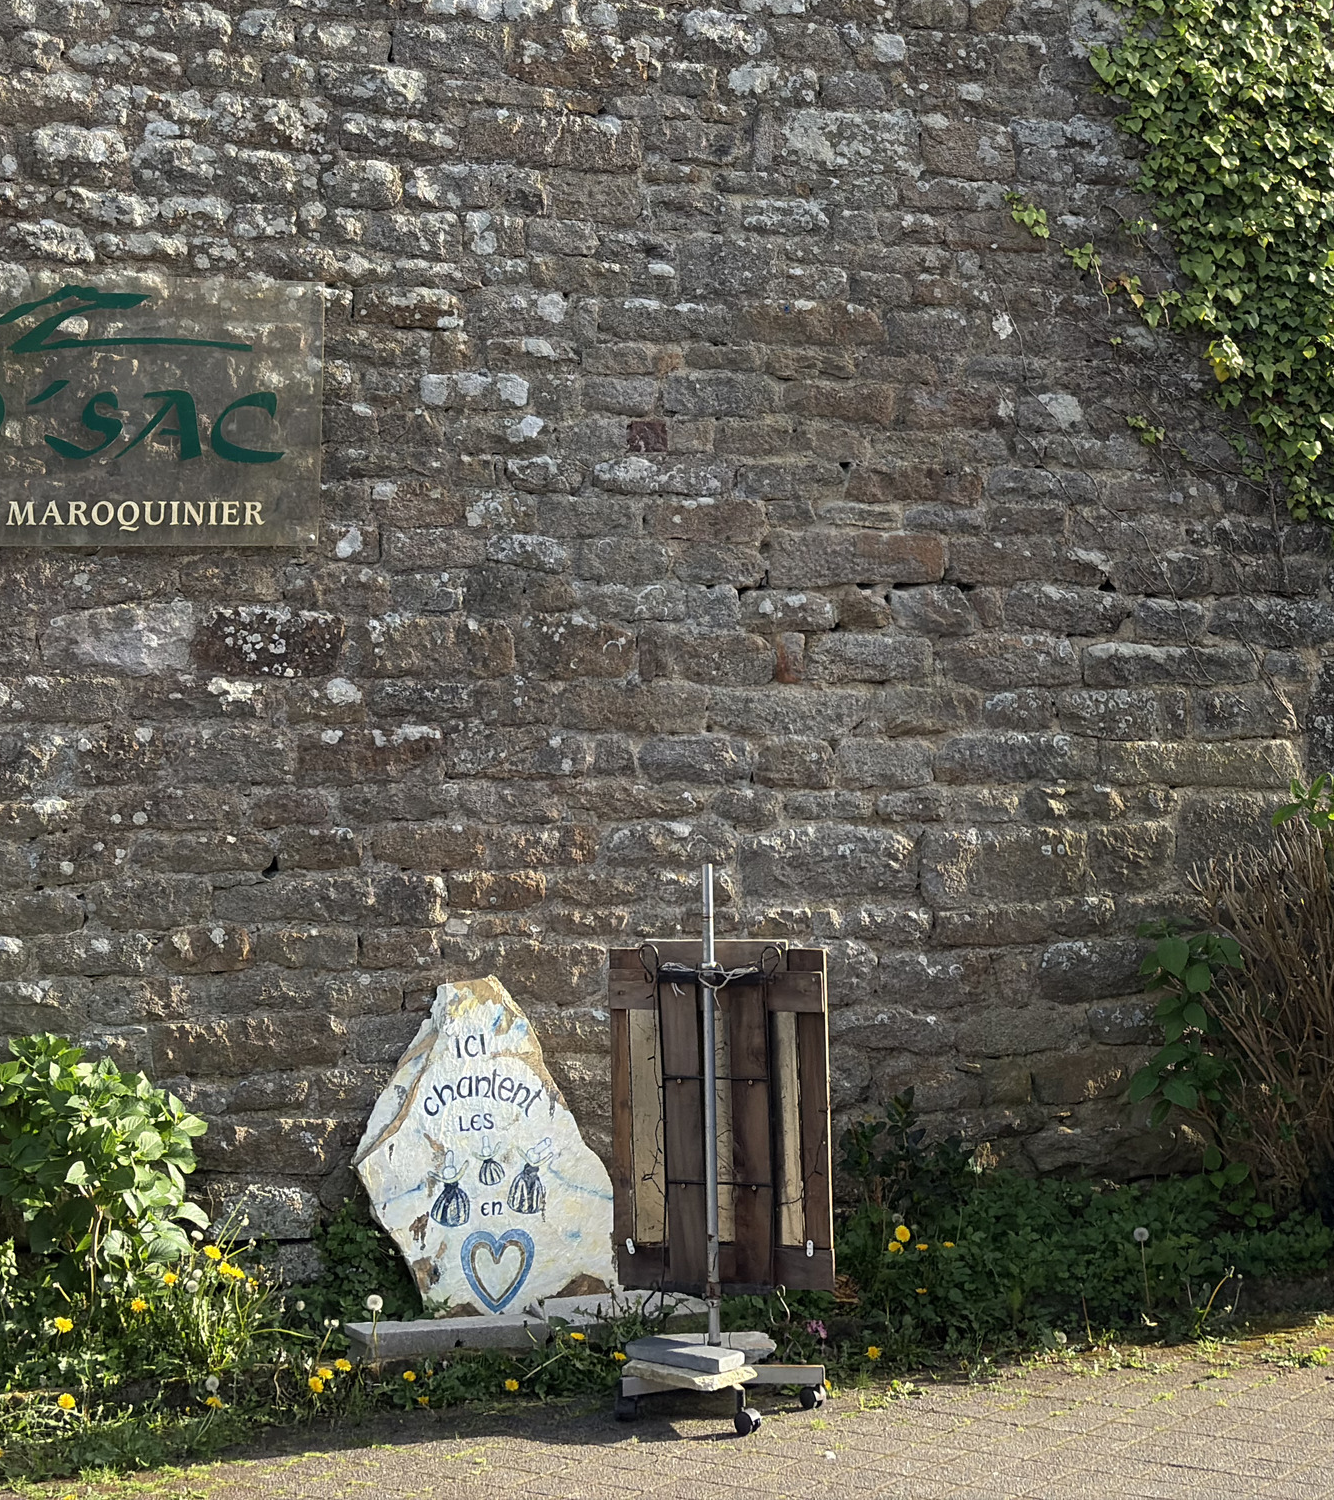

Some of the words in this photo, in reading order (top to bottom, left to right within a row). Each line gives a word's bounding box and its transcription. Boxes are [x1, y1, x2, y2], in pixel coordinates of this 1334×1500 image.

[6, 500, 265, 531] MAROQUINIER
[423, 1068, 543, 1118] chantent
[458, 1113, 495, 1132] LES
